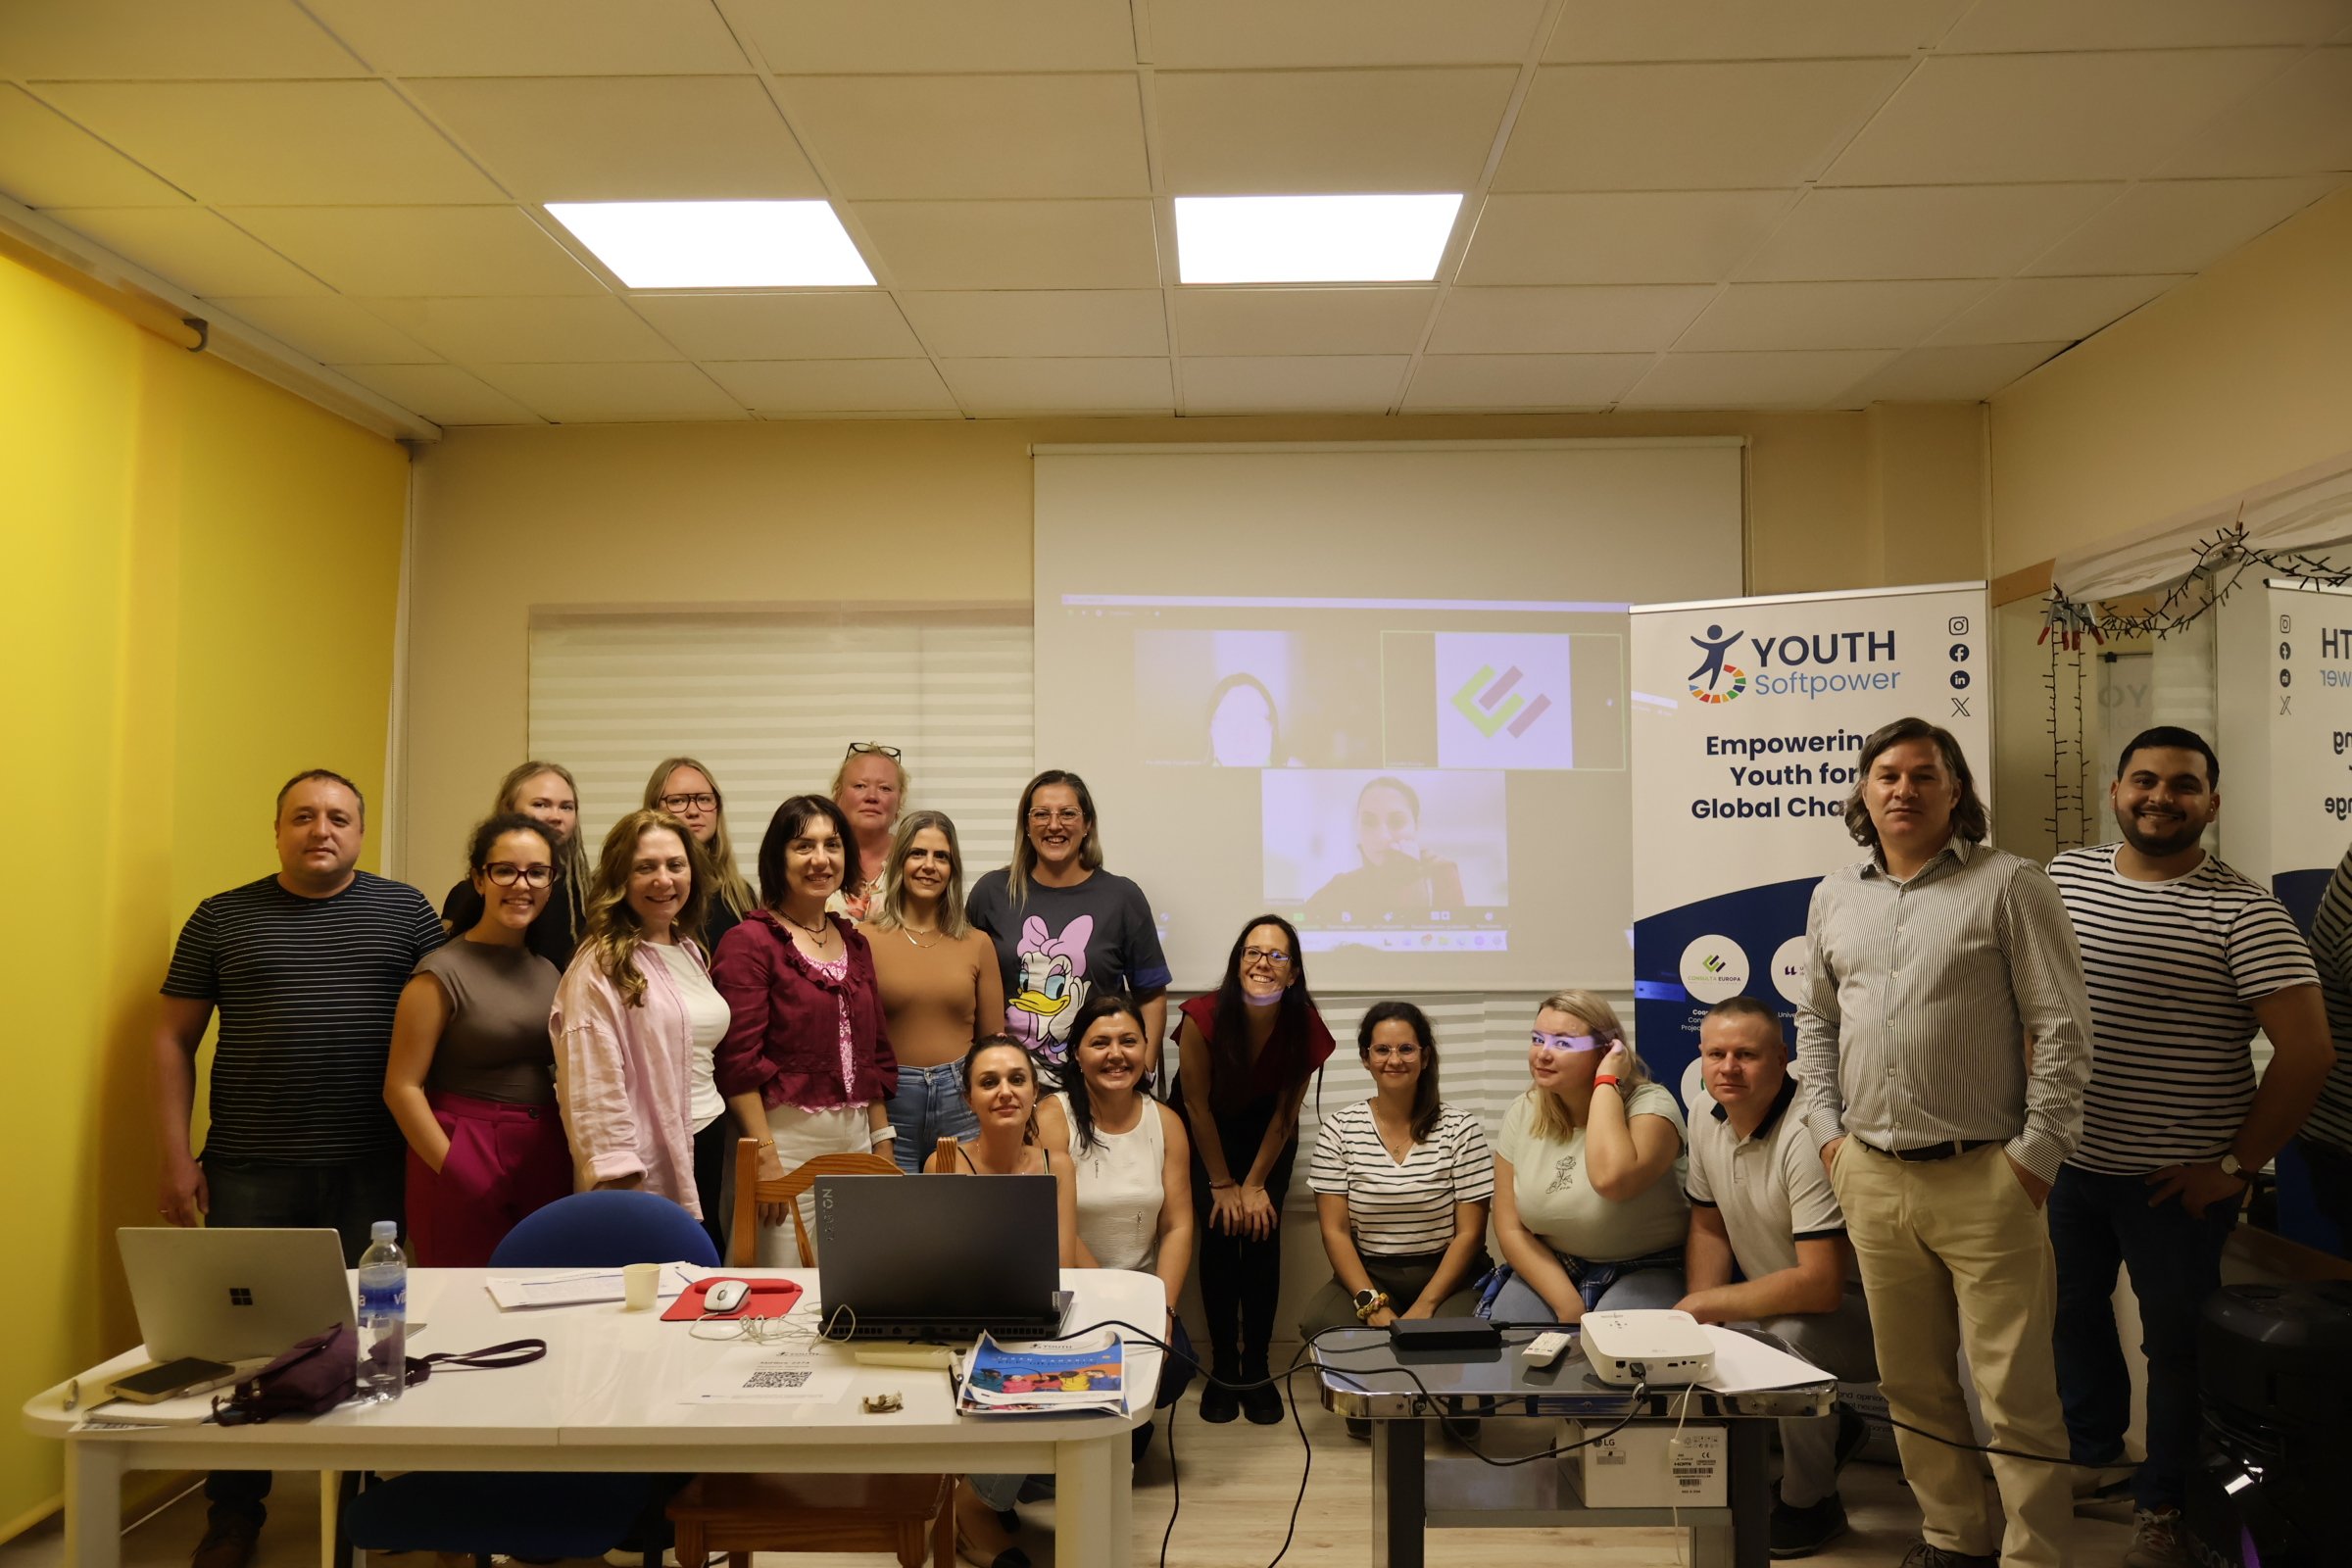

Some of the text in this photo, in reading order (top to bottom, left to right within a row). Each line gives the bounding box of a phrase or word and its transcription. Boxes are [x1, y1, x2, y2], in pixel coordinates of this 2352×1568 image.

[1750, 630, 1895, 667] YOUTH
[1754, 668, 1901, 700] Softpower
[1706, 729, 1873, 760] Empowerin
[1730, 761, 1860, 787] Youth for
[1690, 795, 1845, 819] Global Cha
